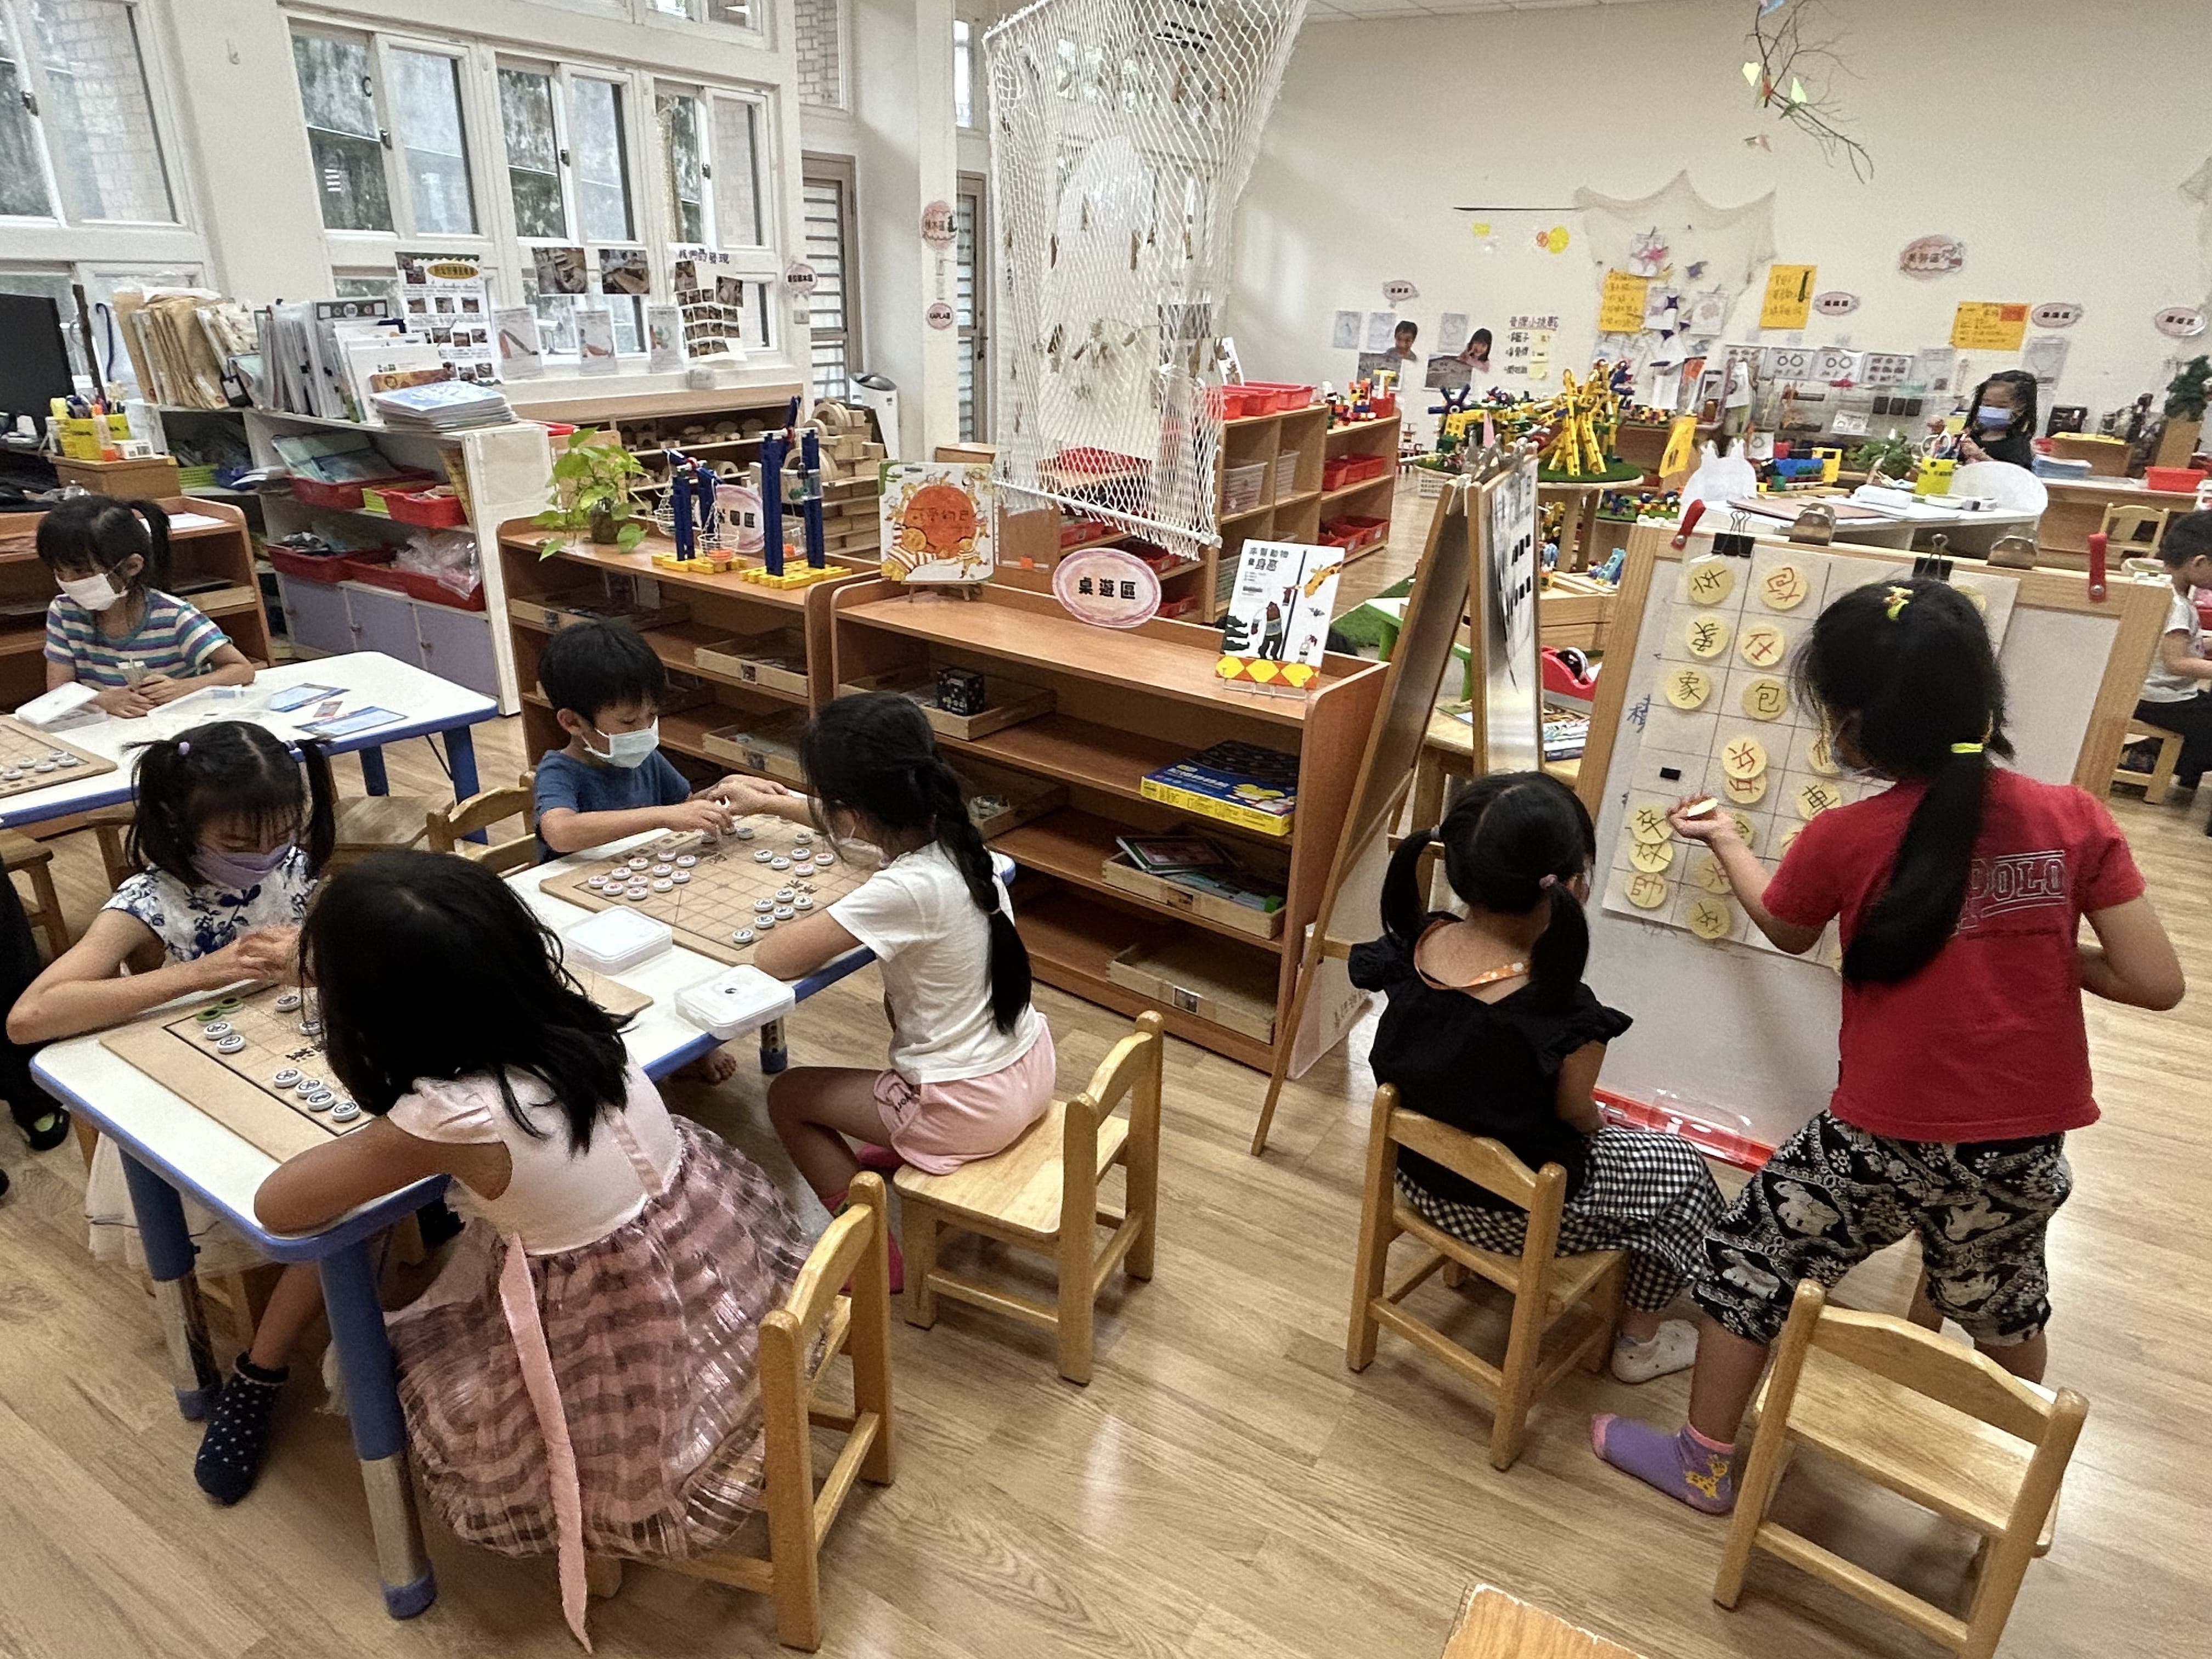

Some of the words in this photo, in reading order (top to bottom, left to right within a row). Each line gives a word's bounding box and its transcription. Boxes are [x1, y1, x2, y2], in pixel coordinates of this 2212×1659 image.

[1078, 577, 1137, 600] 桌遊區
[1677, 672, 1702, 701] 象
